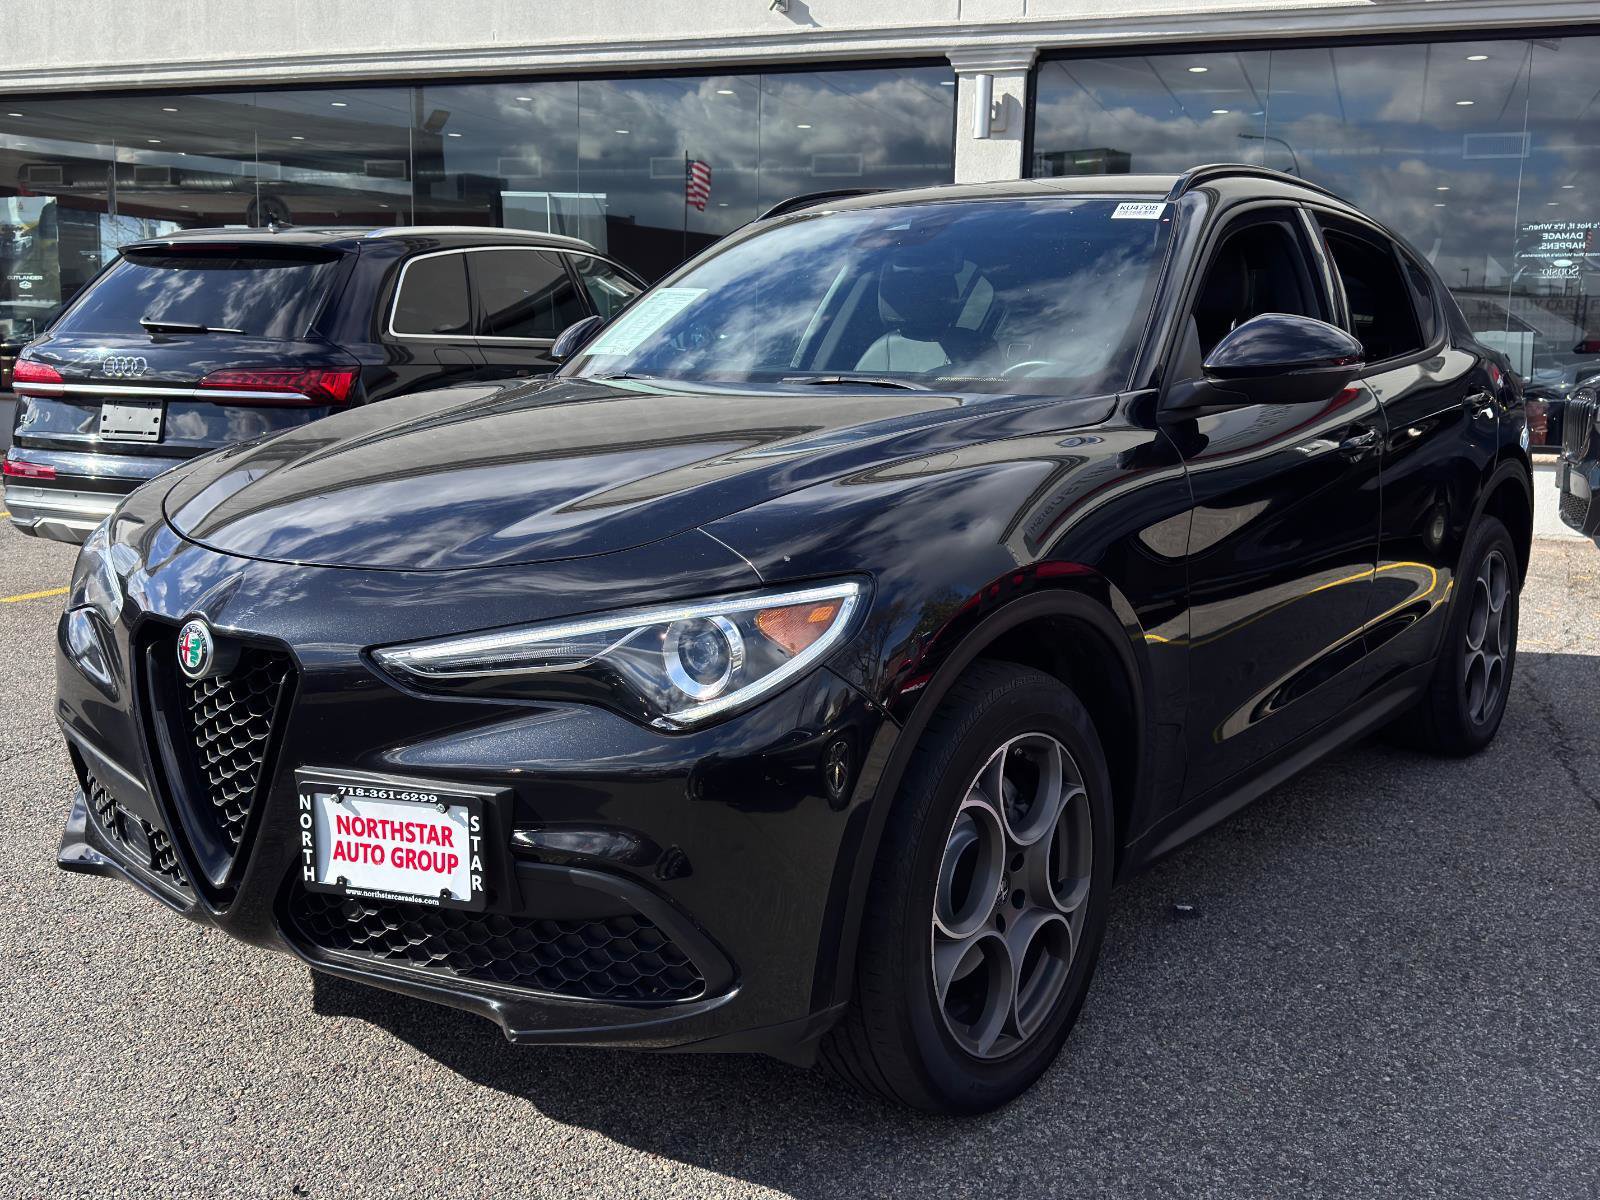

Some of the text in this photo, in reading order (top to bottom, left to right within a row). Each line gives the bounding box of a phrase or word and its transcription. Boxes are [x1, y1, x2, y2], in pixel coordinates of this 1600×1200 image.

[338, 786, 437, 803] 718-361-6299
[300, 794, 316, 882] NORTH
[336, 815, 454, 848] NORTHSTAR
[333, 840, 459, 875] AUTO GROUP
[470, 815, 483, 892] STAR
